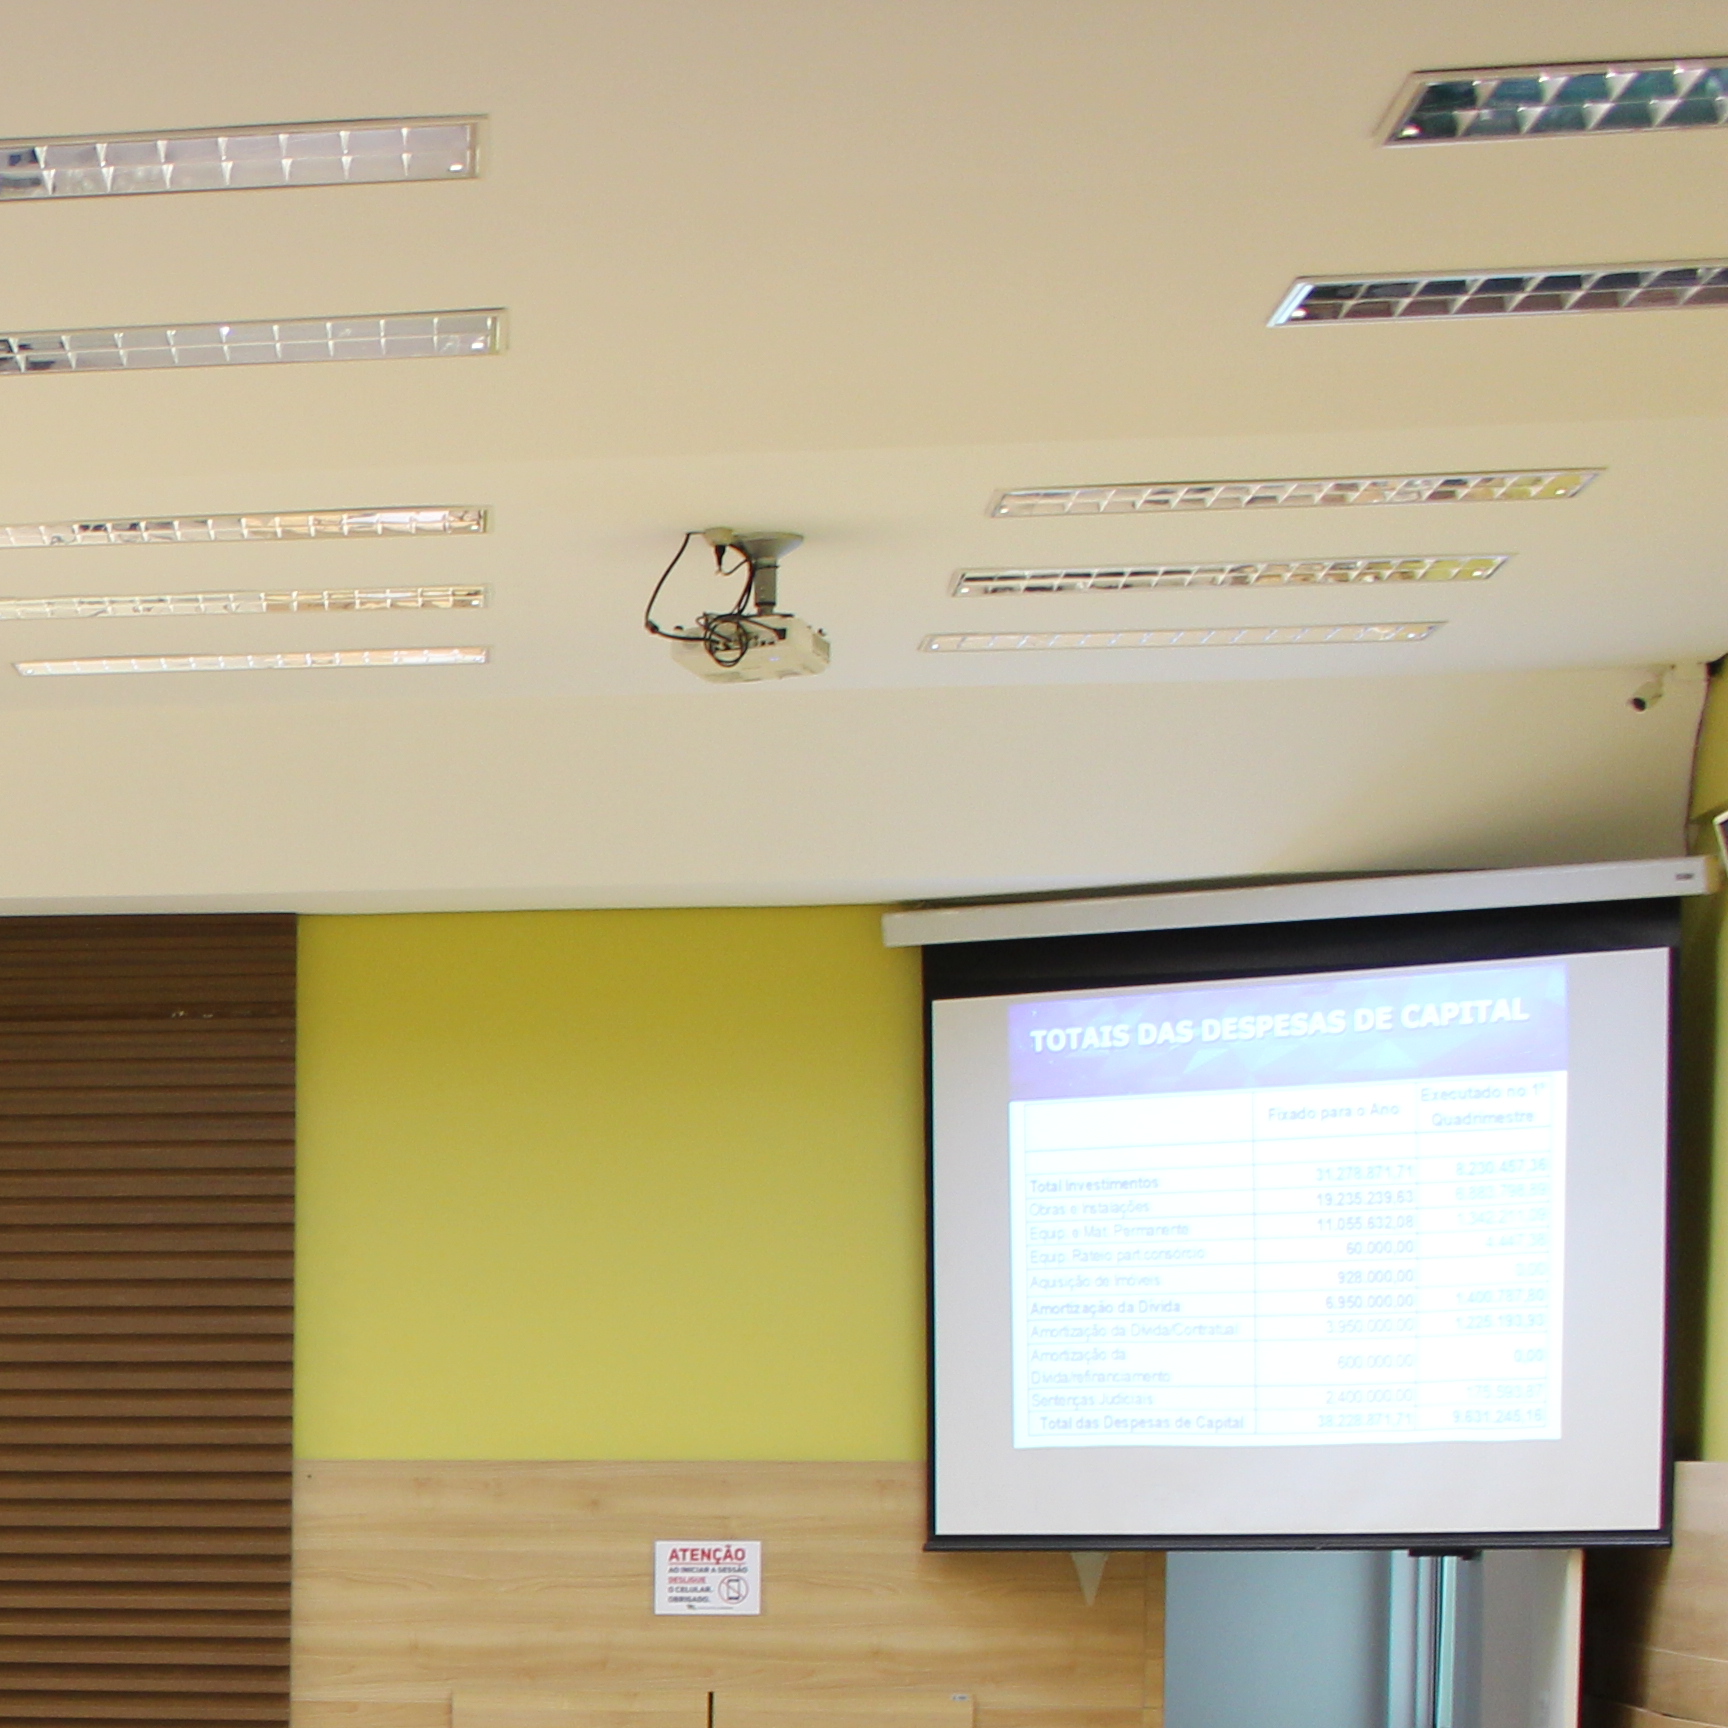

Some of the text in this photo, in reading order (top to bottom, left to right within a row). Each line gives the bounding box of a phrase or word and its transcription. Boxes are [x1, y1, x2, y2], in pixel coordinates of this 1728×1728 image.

[1030, 997, 1530, 1053] TOTAIS DAS DESPESAS DE CAPITAL
[1422, 1086, 1502, 1102] Executado
[1508, 1087, 1527, 1099] no
[1268, 1104, 1400, 1122] Fixado para o Ano
[1432, 1111, 1536, 1126] Quadrimestre
[1030, 1176, 1160, 1193] Total Investimentos
[1029, 1203, 1066, 1217] Obras
[1070, 1206, 1079, 1215] e
[1114, 1223, 1190, 1236] Permanente
[1095, 1276, 1109, 1286] de
[1030, 1298, 1181, 1317] Amortização da Dívida
[1031, 1325, 1108, 1342] Amortização
[1112, 1326, 1127, 1337] da
[1031, 1347, 1127, 1365] Amortização da
[1031, 1392, 1155, 1410] Sentenças Judiciais
[1040, 1414, 1244, 1433] Total das Despesas de Capital
[669, 1544, 746, 1565] ATENÇÃO
